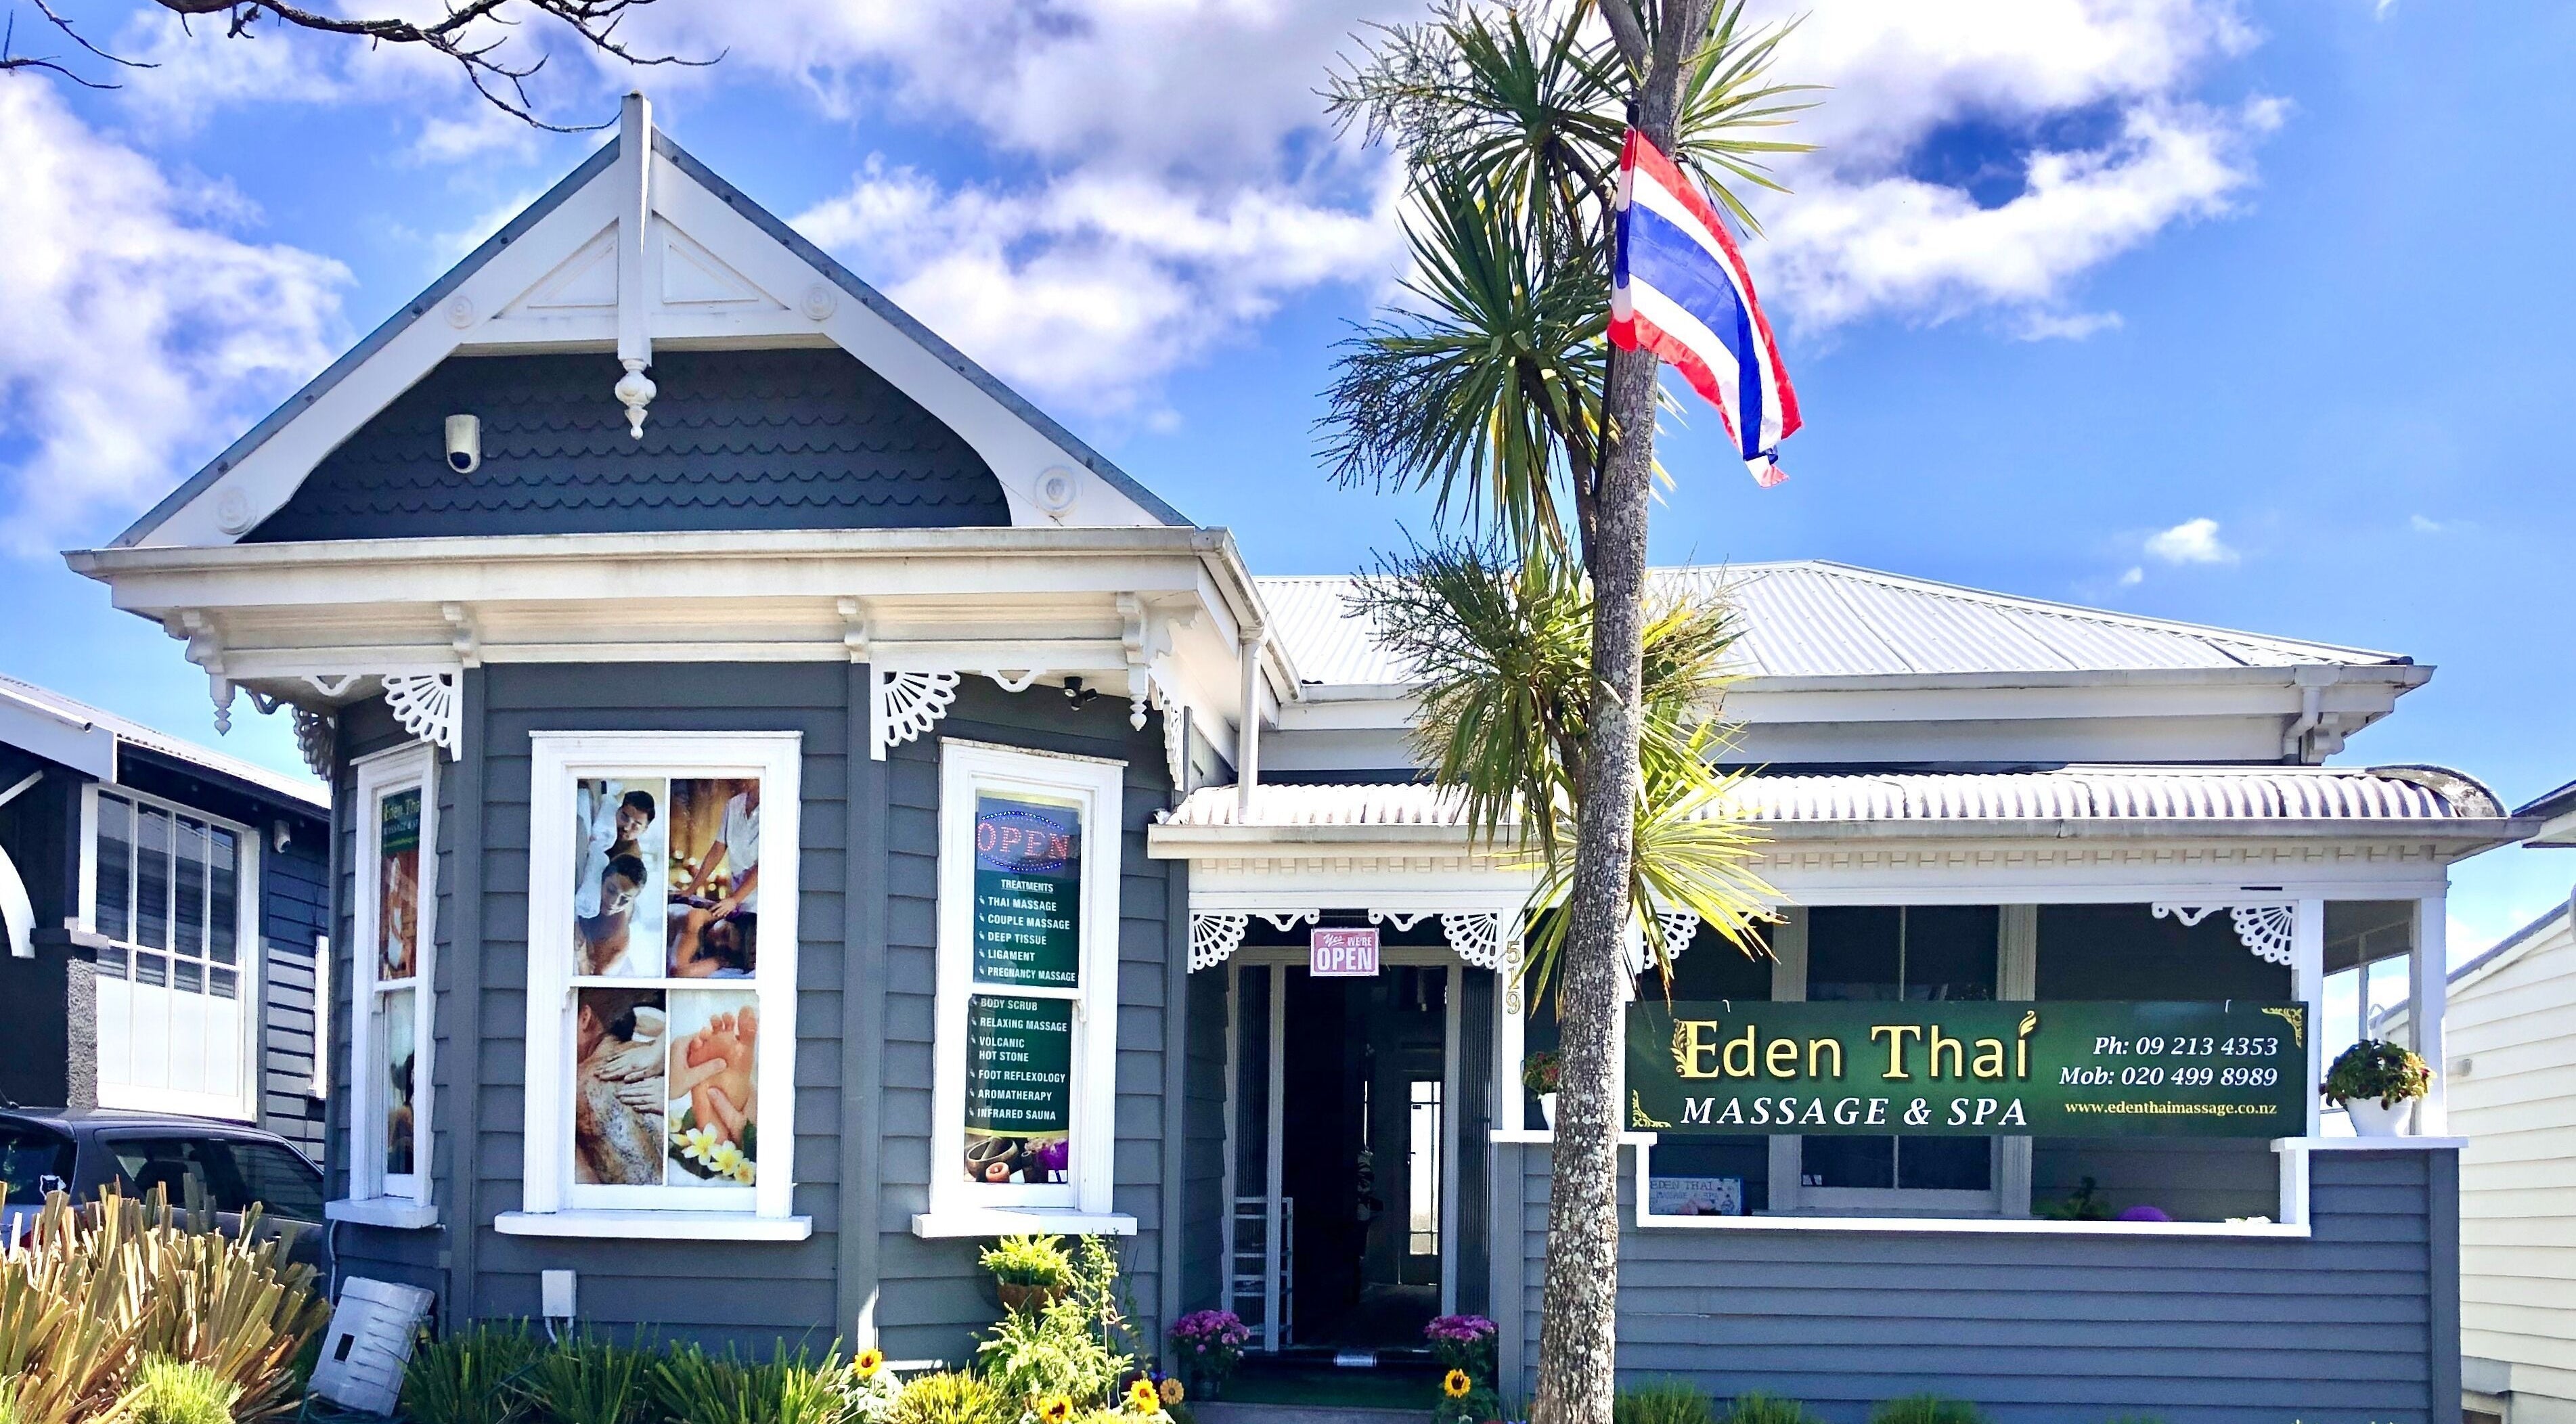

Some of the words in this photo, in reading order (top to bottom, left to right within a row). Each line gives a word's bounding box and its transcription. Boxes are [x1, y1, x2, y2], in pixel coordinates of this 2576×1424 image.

[977, 822, 1069, 860] OPEN
[1001, 879, 1054, 892] TREATMENTS
[988, 897, 1009, 907] THAI
[1013, 898, 1057, 912] MASSAGE
[988, 914, 1023, 927] COUPLE
[1027, 917, 1070, 930] MASSAGE
[988, 932, 1011, 942] DEEP
[1015, 933, 1046, 945] TISSUE
[1323, 934, 1345, 947] Yes
[988, 950, 1035, 961] LIGAMENT
[1317, 947, 1372, 971] OPEN
[988, 966, 1036, 979] PREGNANCY
[1038, 970, 1075, 981] MASSAGE
[981, 998, 1004, 1008] BODY
[1008, 1000, 1038, 1011] SCRUB
[980, 1017, 1023, 1029] RELAXING
[1026, 1020, 1067, 1031] MASSAGE
[979, 1036, 1025, 1048] VOLCANIC
[1671, 1019, 1842, 1078] Eden
[1871, 1010, 2036, 1078] Thai
[2093, 1036, 2129, 1055] Ph:
[2136, 1036, 2164, 1055] 09
[2171, 1037, 2213, 1055] 213
[2221, 1037, 2278, 1056] 4353
[979, 1050, 998, 1061] HOT
[1000, 1051, 1029, 1062] STONE
[979, 1070, 1002, 1080] FOOT
[1004, 1071, 1065, 1083] REFLEXOLOGY
[2059, 1067, 2114, 1084] Mob:
[2121, 1067, 2164, 1085] 020
[2171, 1067, 2213, 1086] 499
[2220, 1067, 2278, 1086] 8989
[978, 1089, 1052, 1101] AROMATHERAPY
[977, 1108, 1023, 1119] INFRARED
[1026, 1110, 1056, 1120] SAUNA
[1680, 1097, 1889, 1125] MASSAGE
[1903, 1098, 1932, 1126] &
[1947, 1098, 2027, 1126] SPA
[2065, 1100, 2278, 1116] www.edenthaimassage.co.nz
[1650, 1180, 1679, 1189] EDEN
[1683, 1181, 1712, 1190] THAI
